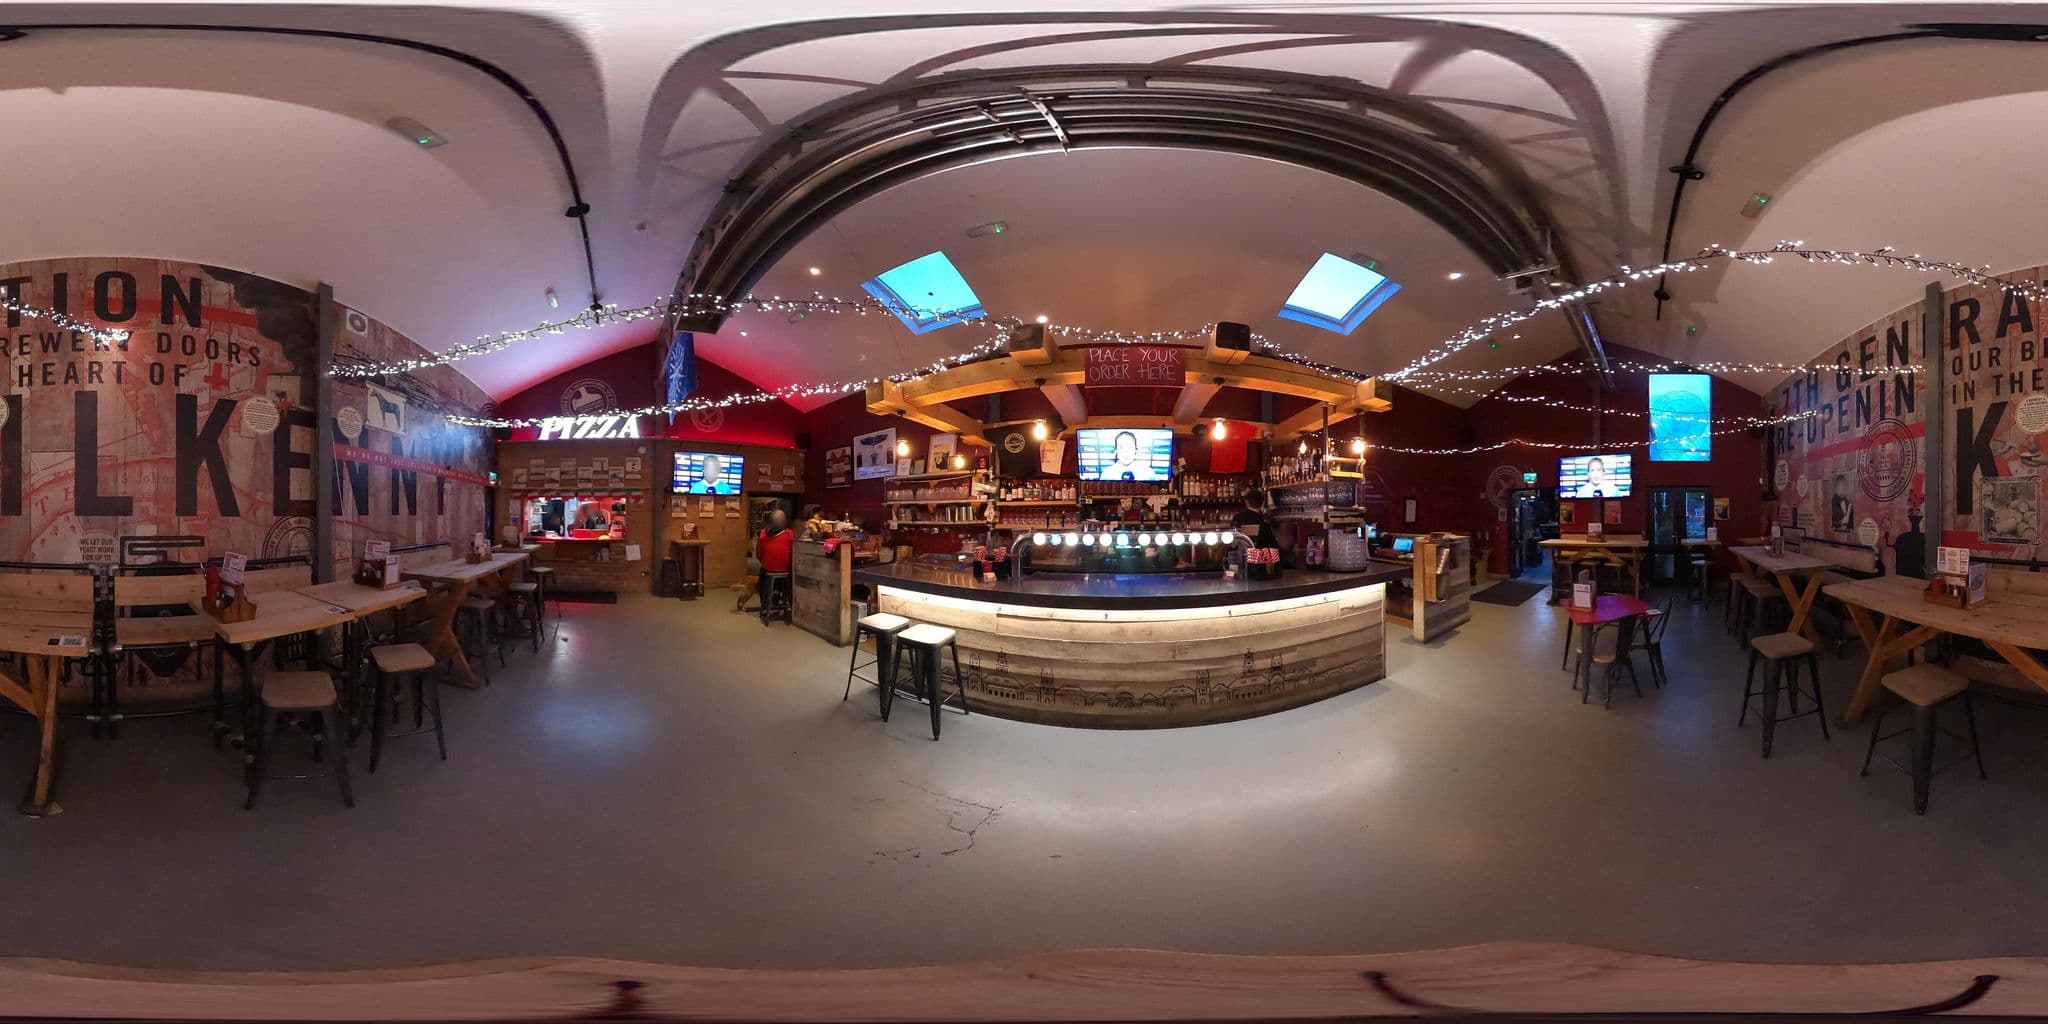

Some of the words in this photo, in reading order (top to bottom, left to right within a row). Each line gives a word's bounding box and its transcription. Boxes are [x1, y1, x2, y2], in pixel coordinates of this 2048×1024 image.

[157, 332, 260, 367] DOORS
[1089, 348, 1130, 362] PLACE
[1139, 347, 1180, 364] YOUR
[1952, 347, 2001, 376] OUR
[18, 360, 127, 388] HEART
[150, 362, 188, 386] OF
[1089, 363, 1130, 381] ORDER
[1137, 362, 1177, 381] HERE
[1952, 380, 1975, 405] IN
[1992, 368, 2045, 396] THE
[538, 415, 640, 441] PIZZA
